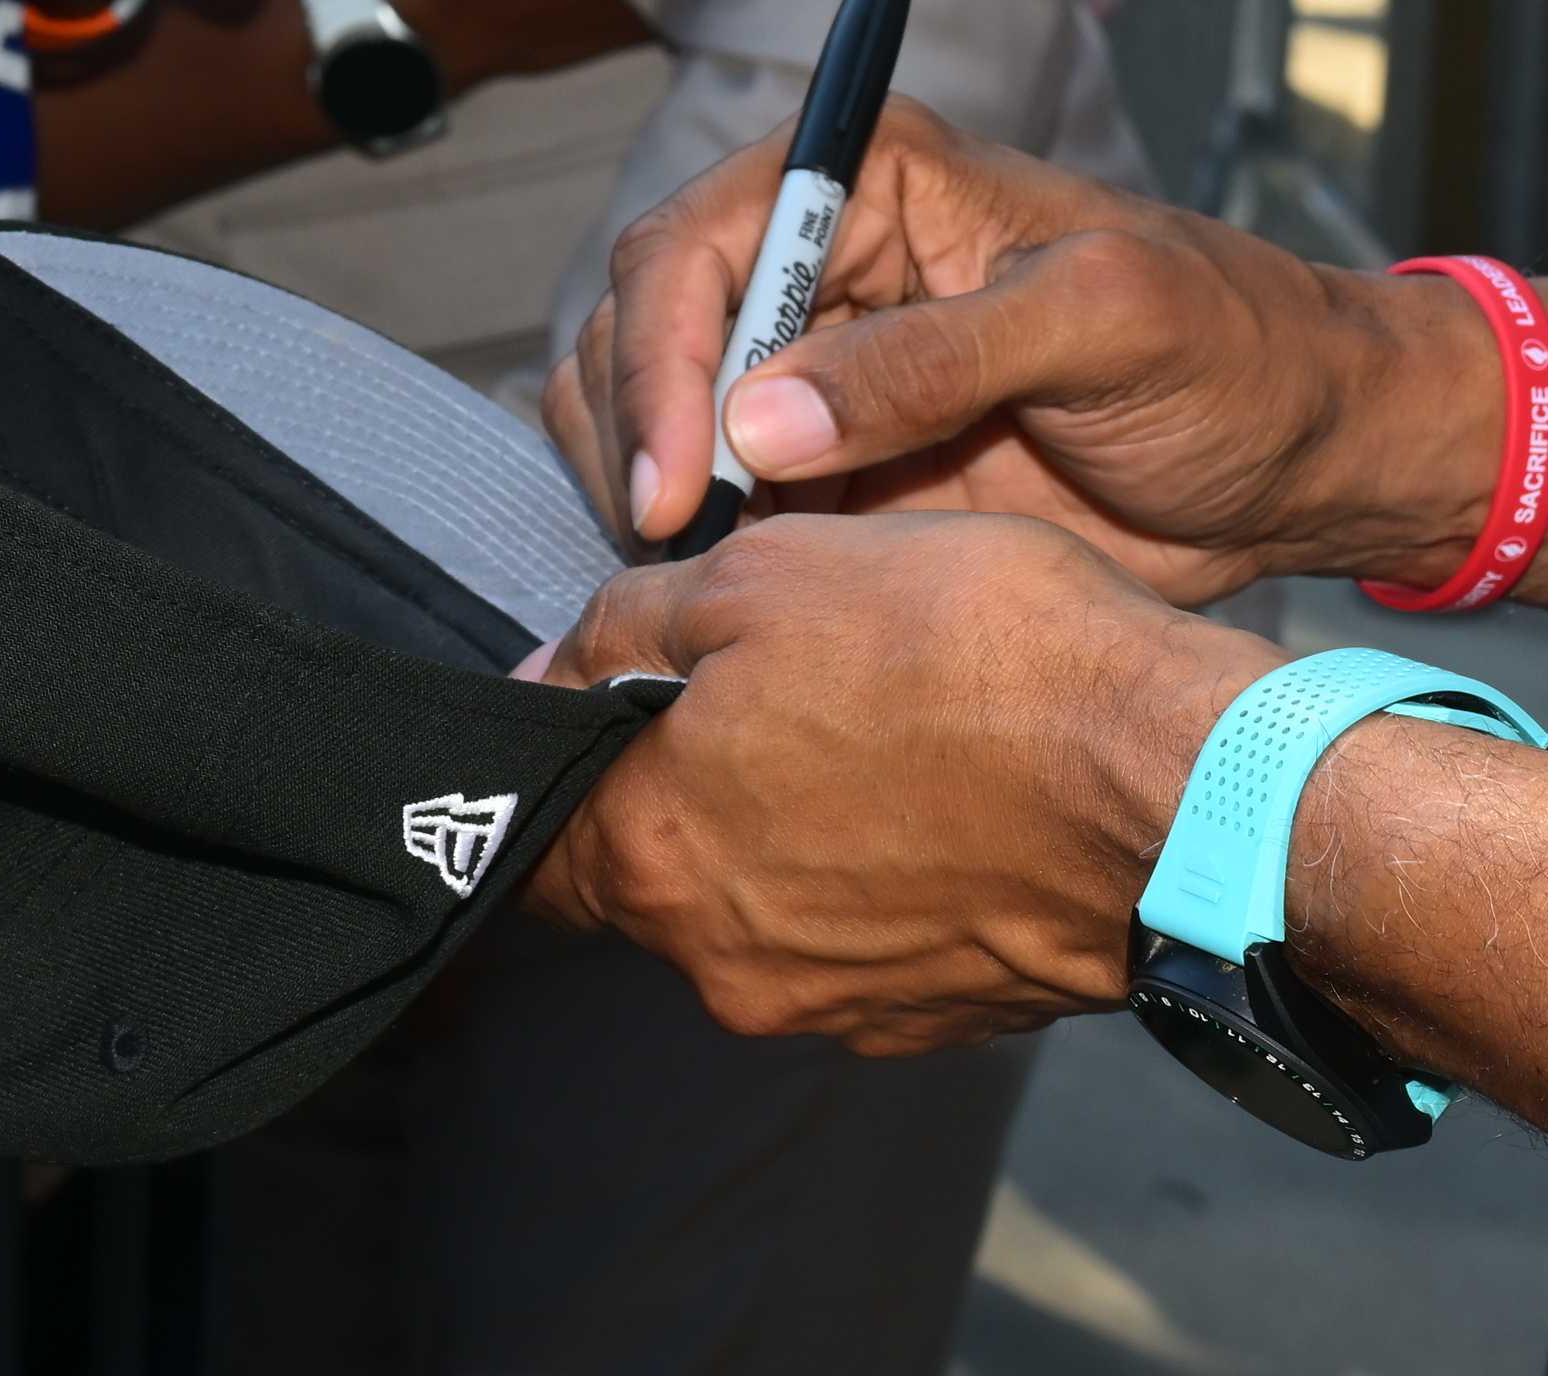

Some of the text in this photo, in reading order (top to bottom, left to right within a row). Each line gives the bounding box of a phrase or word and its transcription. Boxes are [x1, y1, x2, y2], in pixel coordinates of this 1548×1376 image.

[799, 208, 820, 240] FINE
[813, 205, 835, 248] POINT
[1188, 1007, 1209, 1022] 10
[1227, 1028, 1247, 1044] 11
[1265, 1053, 1287, 1072] 12
